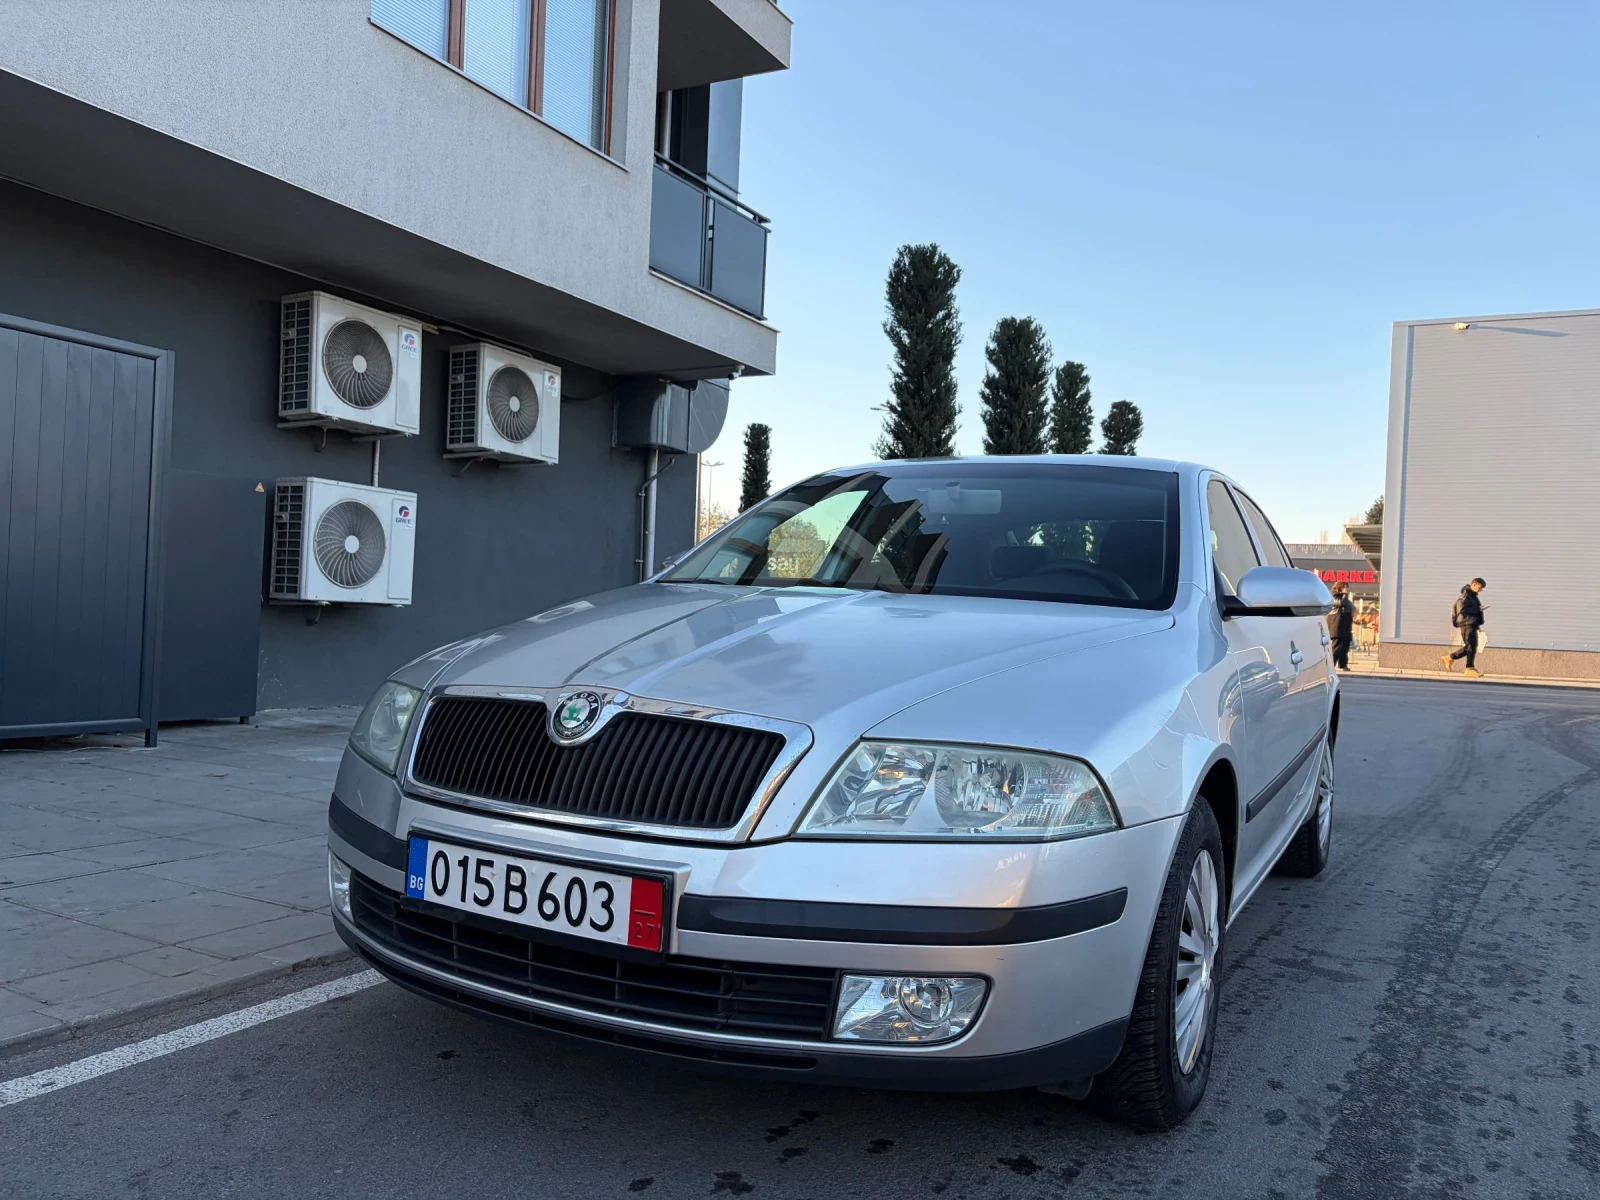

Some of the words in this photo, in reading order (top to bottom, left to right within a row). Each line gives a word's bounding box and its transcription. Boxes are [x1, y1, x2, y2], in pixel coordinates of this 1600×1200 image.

[1309, 569, 1382, 583] ARKE
[409, 874, 424, 891] BG
[634, 921, 655, 941] 27
